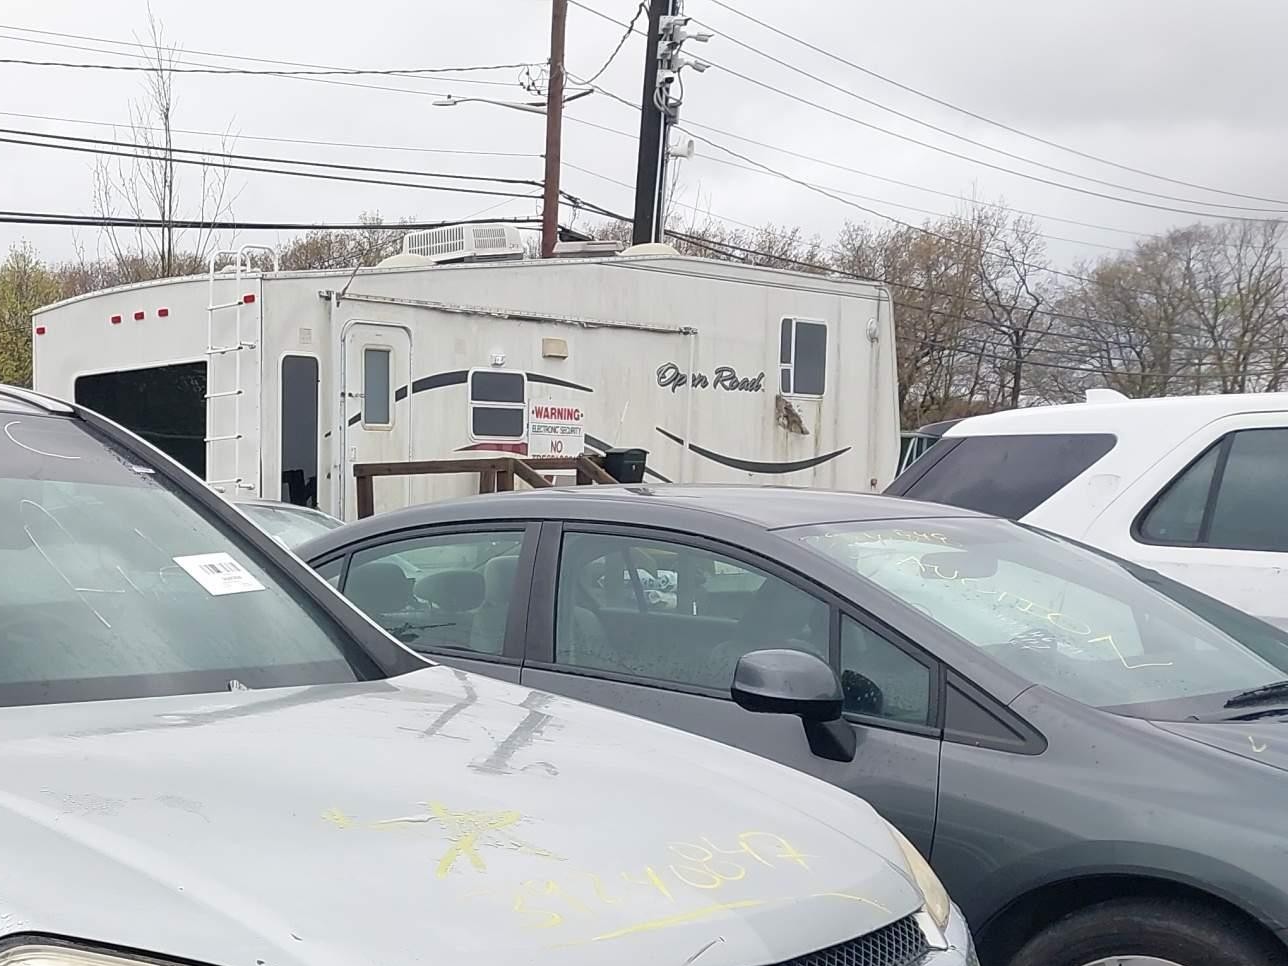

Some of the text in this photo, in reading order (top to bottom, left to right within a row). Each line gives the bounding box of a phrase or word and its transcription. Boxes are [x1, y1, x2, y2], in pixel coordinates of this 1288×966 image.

[713, 366, 765, 392] Road
[535, 406, 580, 421] WARNING
[551, 439, 563, 453] NO
